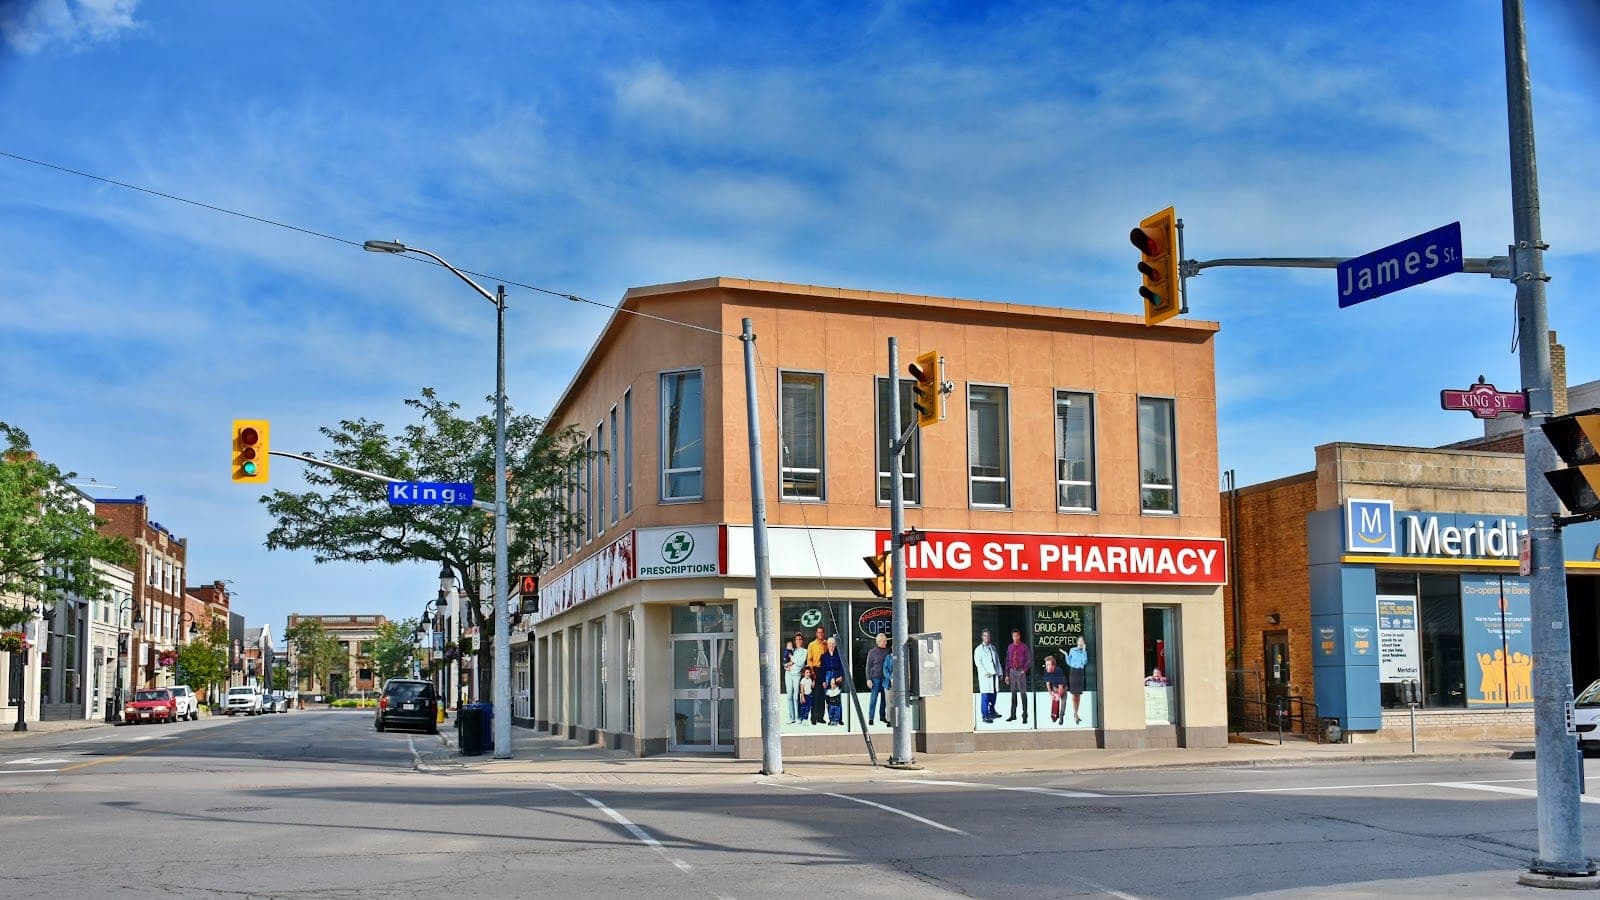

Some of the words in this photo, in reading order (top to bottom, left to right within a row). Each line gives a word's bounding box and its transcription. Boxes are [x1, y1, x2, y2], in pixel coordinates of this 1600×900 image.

[1343, 244, 1439, 296] James
[1443, 247, 1459, 264] St.
[1461, 394, 1489, 408] KING
[1494, 395, 1510, 408] ST.
[393, 485, 456, 504] King
[1360, 506, 1381, 534] M
[1408, 515, 1528, 557] Meridi
[983, 543, 1029, 571] ST.
[1040, 544, 1217, 575] PHARMACY
[640, 563, 716, 577] PRESCRIPTIONS
[1512, 586, 1531, 595] Bank
[1037, 609, 1051, 619] ALL
[1052, 609, 1079, 620] MAJOR
[868, 620, 892, 635] OPE
[1034, 622, 1056, 633] DRUG
[1057, 622, 1082, 633] PLANS
[1038, 635, 1078, 646] ACCEPTED
